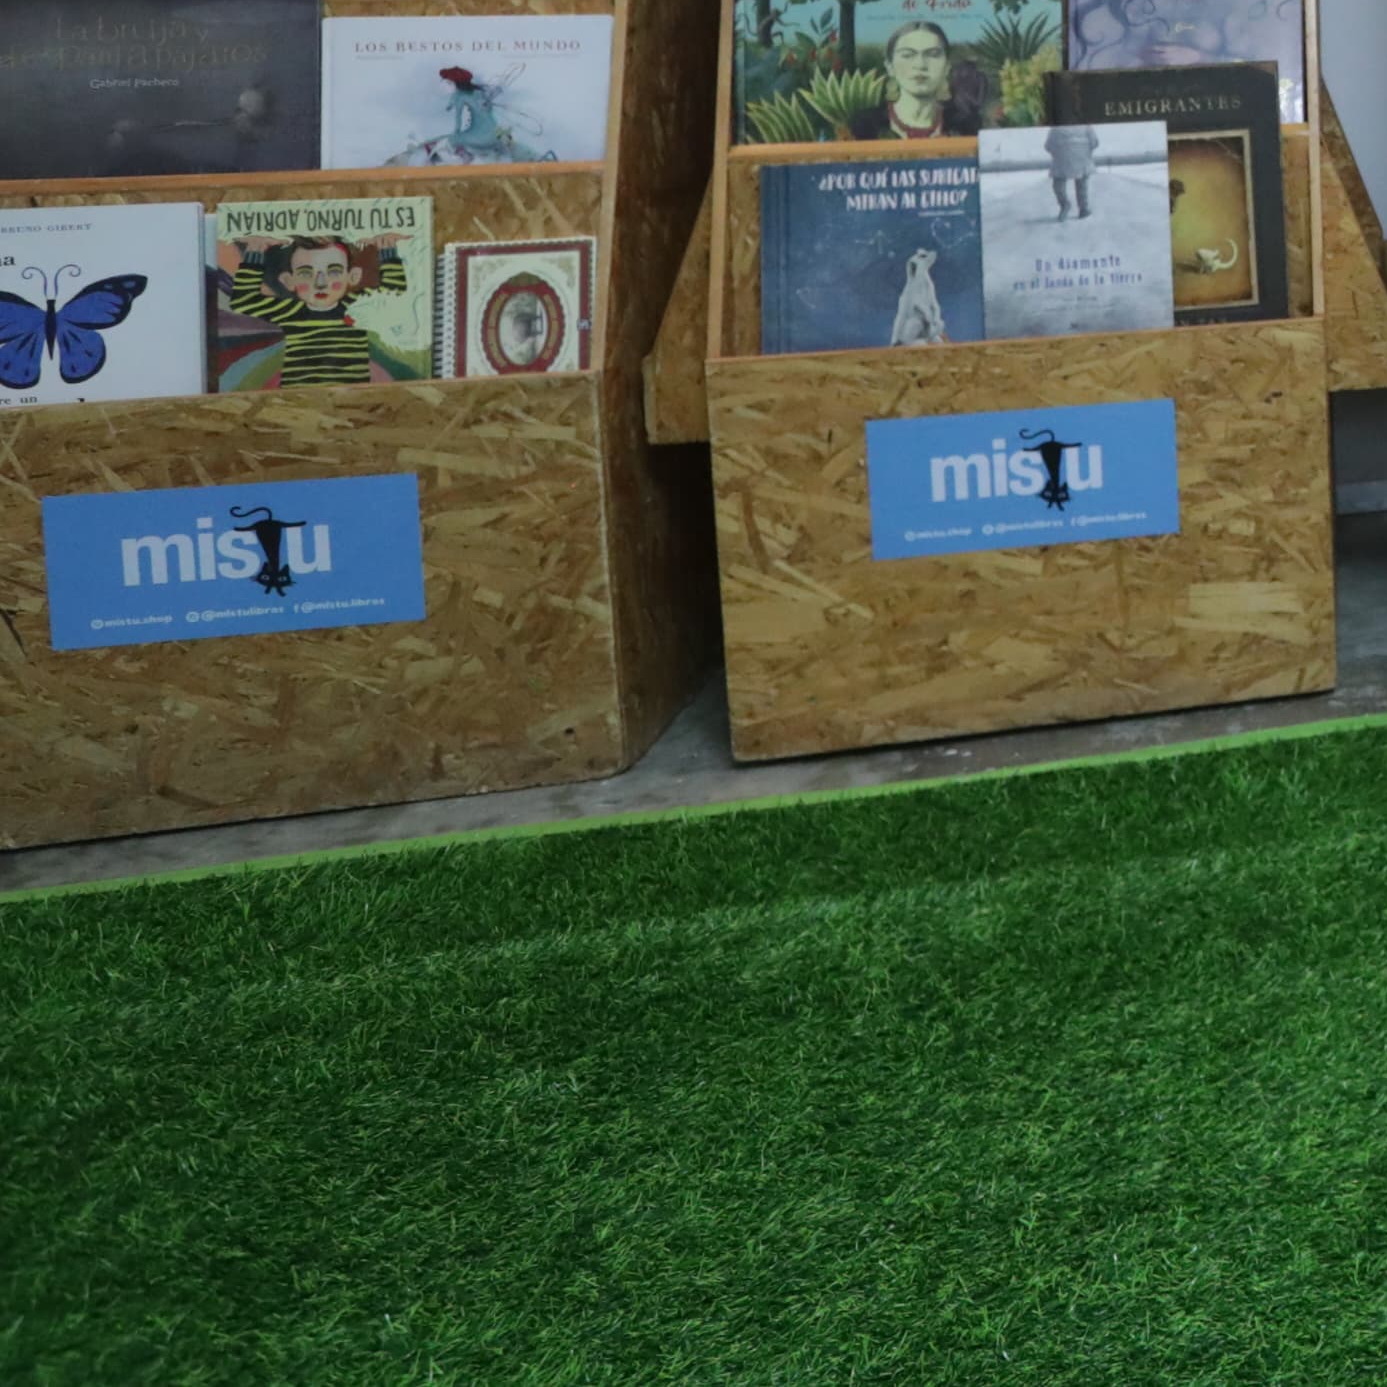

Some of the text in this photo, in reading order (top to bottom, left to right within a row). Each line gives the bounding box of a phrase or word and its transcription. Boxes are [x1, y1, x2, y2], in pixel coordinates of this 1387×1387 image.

[355, 39, 581, 53] LOS RESTOS DEL MUNDO
[1104, 95, 1243, 117] EMIGRANTES
[227, 210, 298, 236] ADRIÁN
